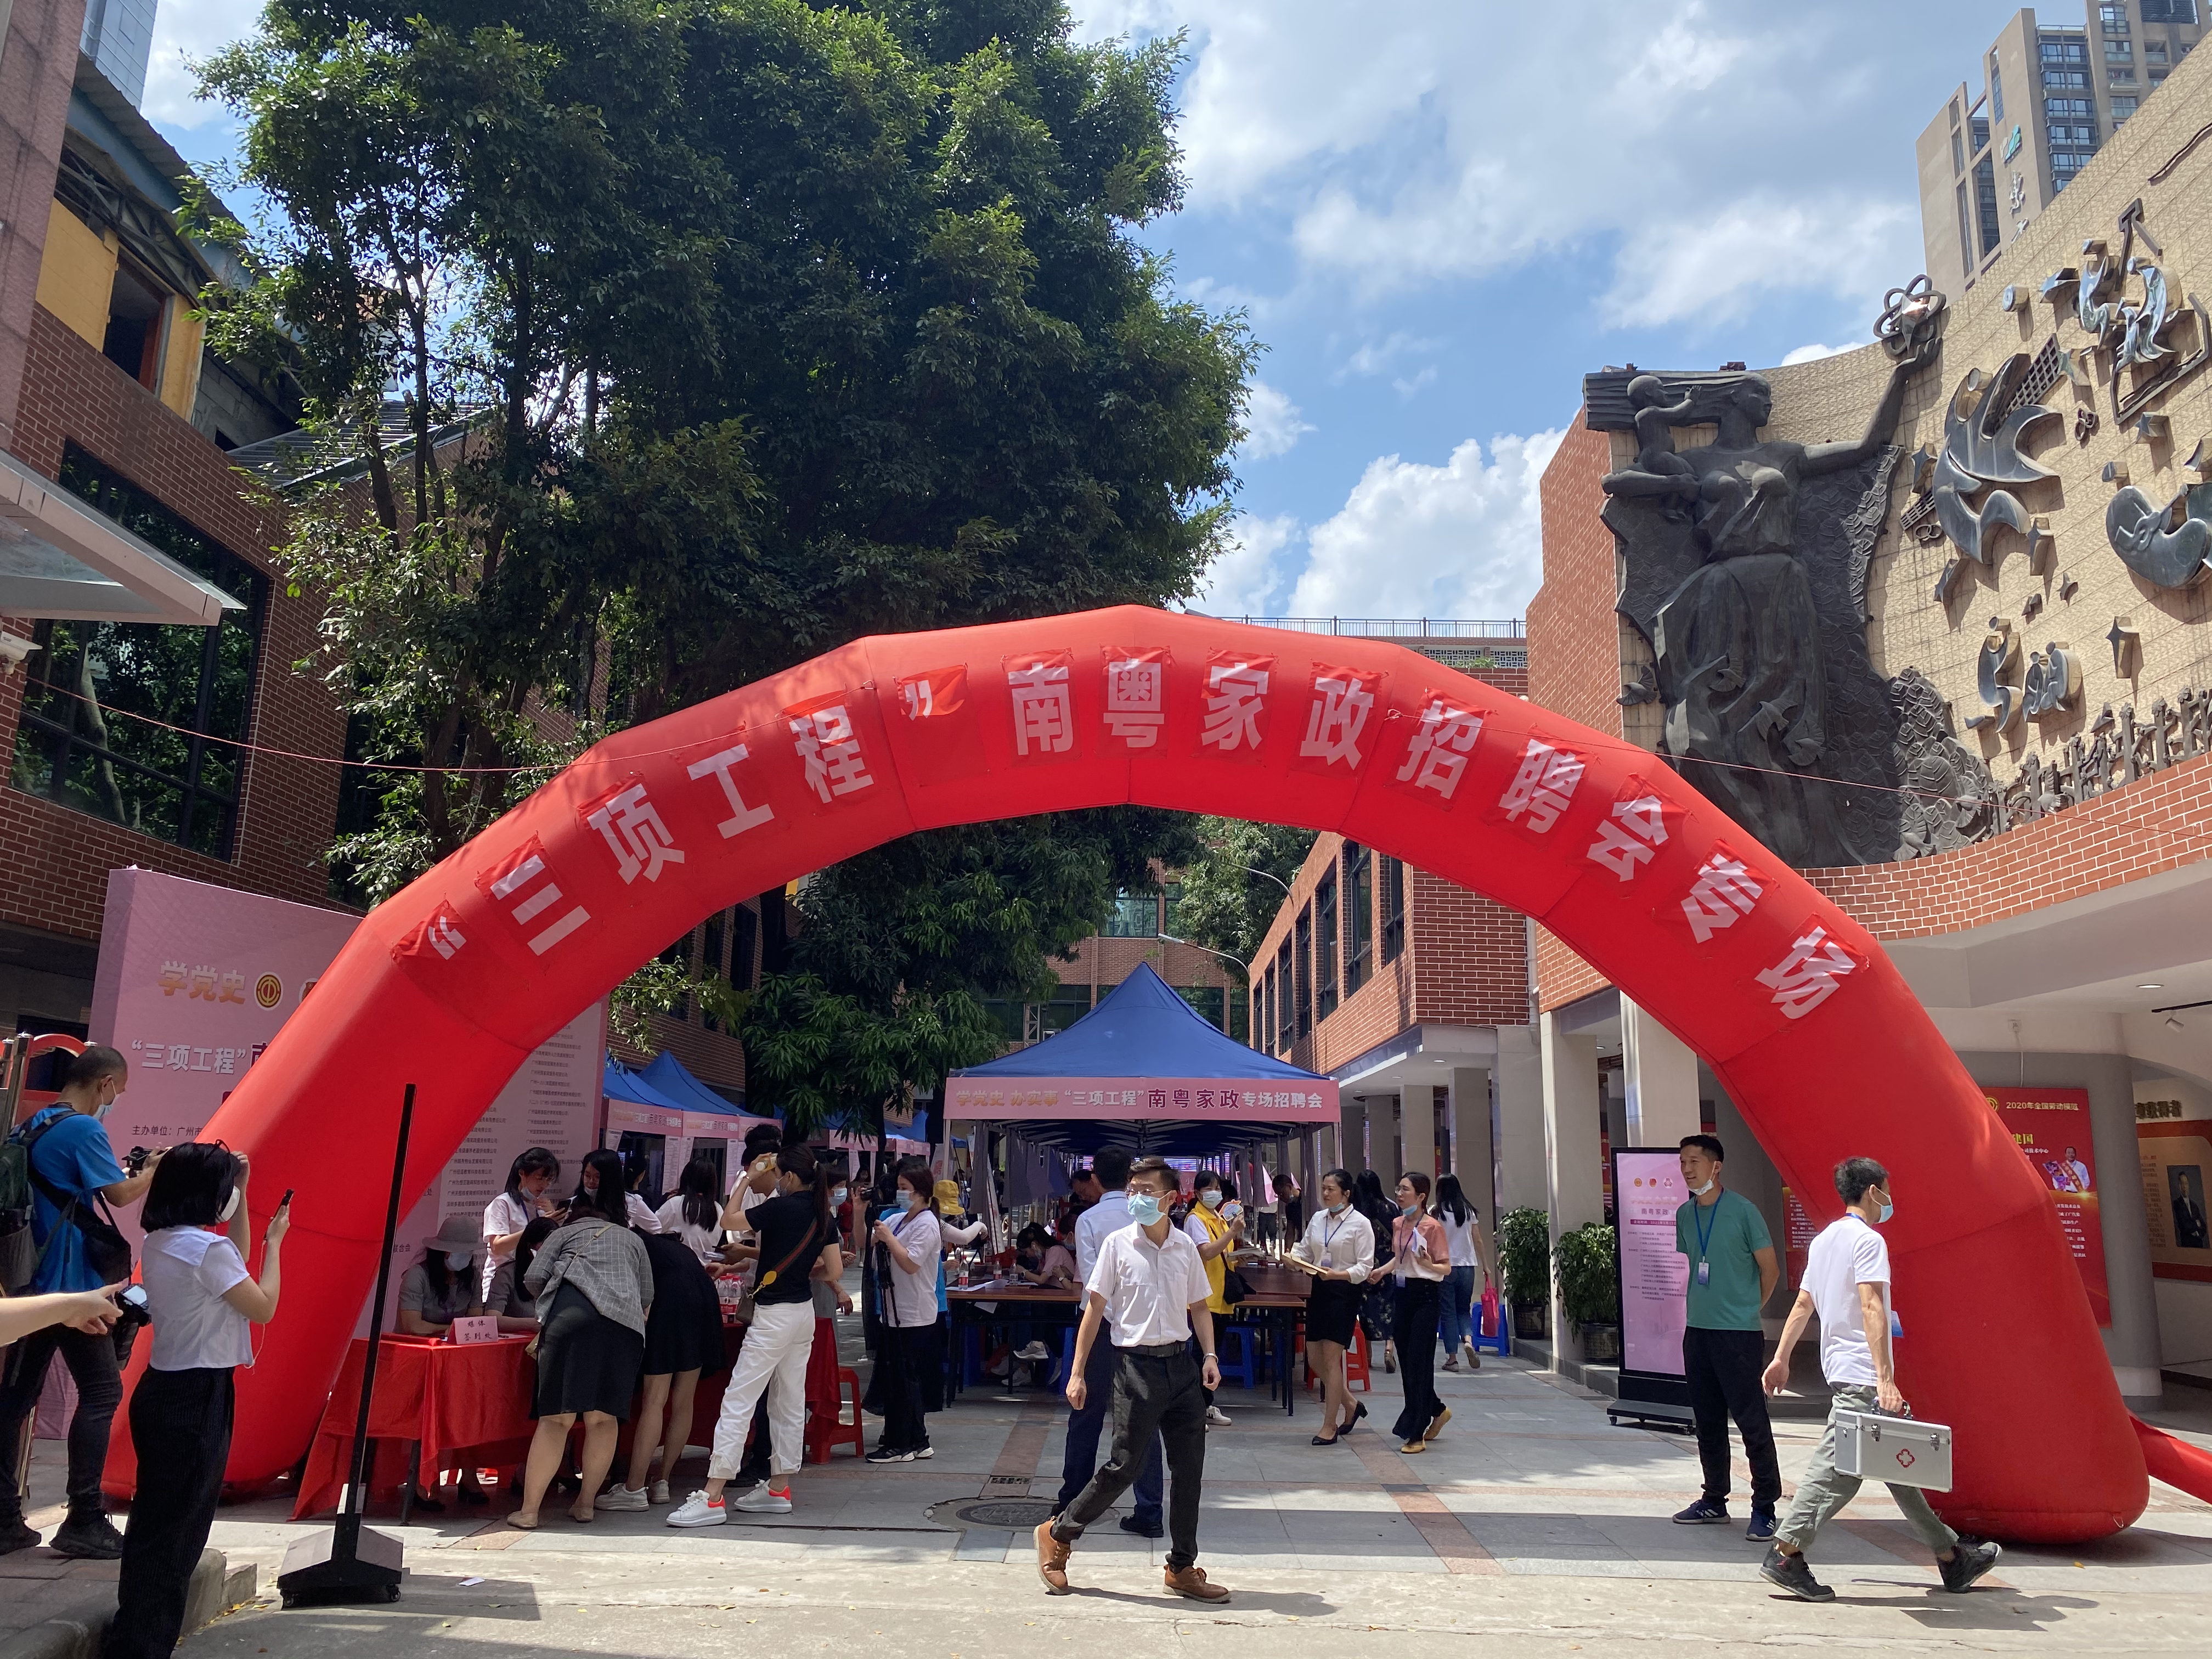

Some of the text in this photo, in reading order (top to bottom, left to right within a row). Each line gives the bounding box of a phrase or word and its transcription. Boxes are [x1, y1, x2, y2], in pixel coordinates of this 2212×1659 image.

[159, 961, 245, 1004] 学党史
[956, 1088, 1323, 1110] 学党史 办实事 “三项工程”南粤家政专场招聘会
[2006, 1101, 2079, 1111] 2020年全国劳动模范
[467, 1319, 486, 1328] 媒体
[464, 1332, 492, 1341] 签到处
